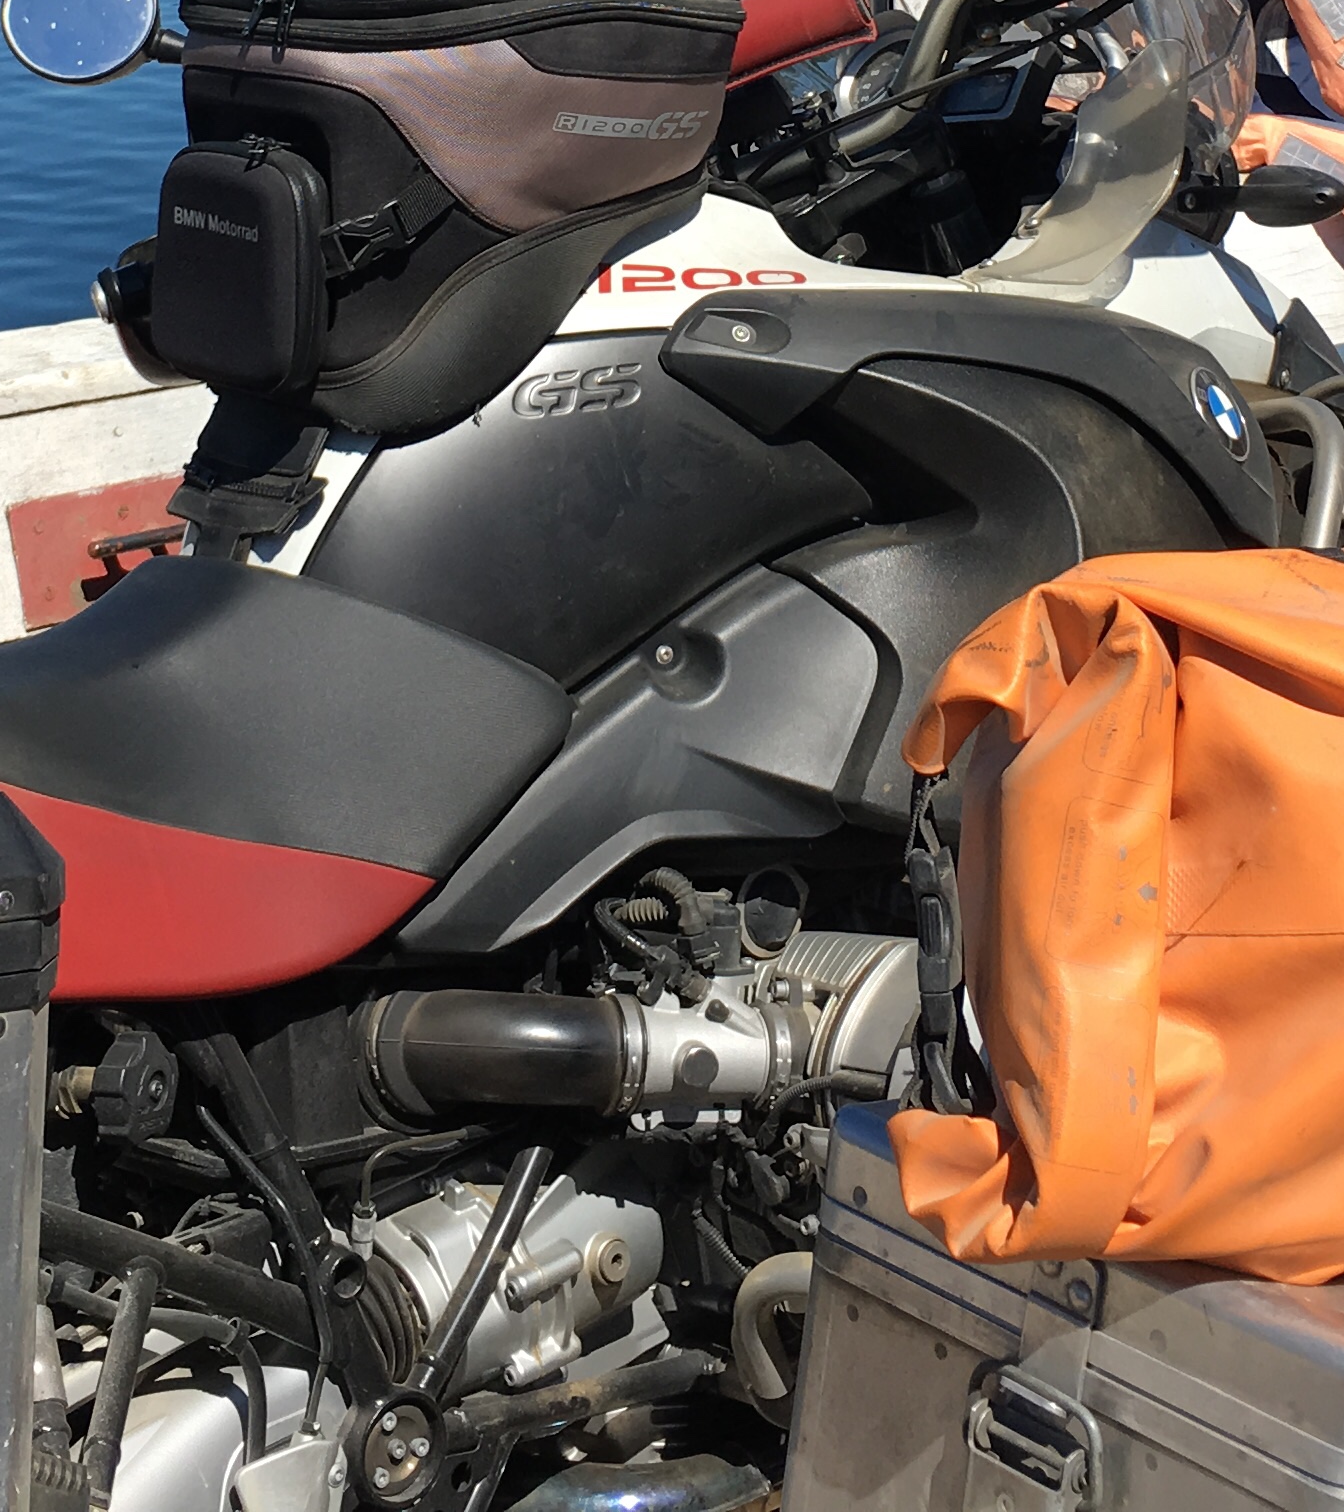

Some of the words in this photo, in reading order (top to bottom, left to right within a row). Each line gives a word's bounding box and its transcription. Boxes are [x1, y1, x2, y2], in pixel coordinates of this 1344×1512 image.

[174, 206, 205, 229] BMW
[208, 213, 259, 242] Motorrad
[511, 363, 643, 419] GS
